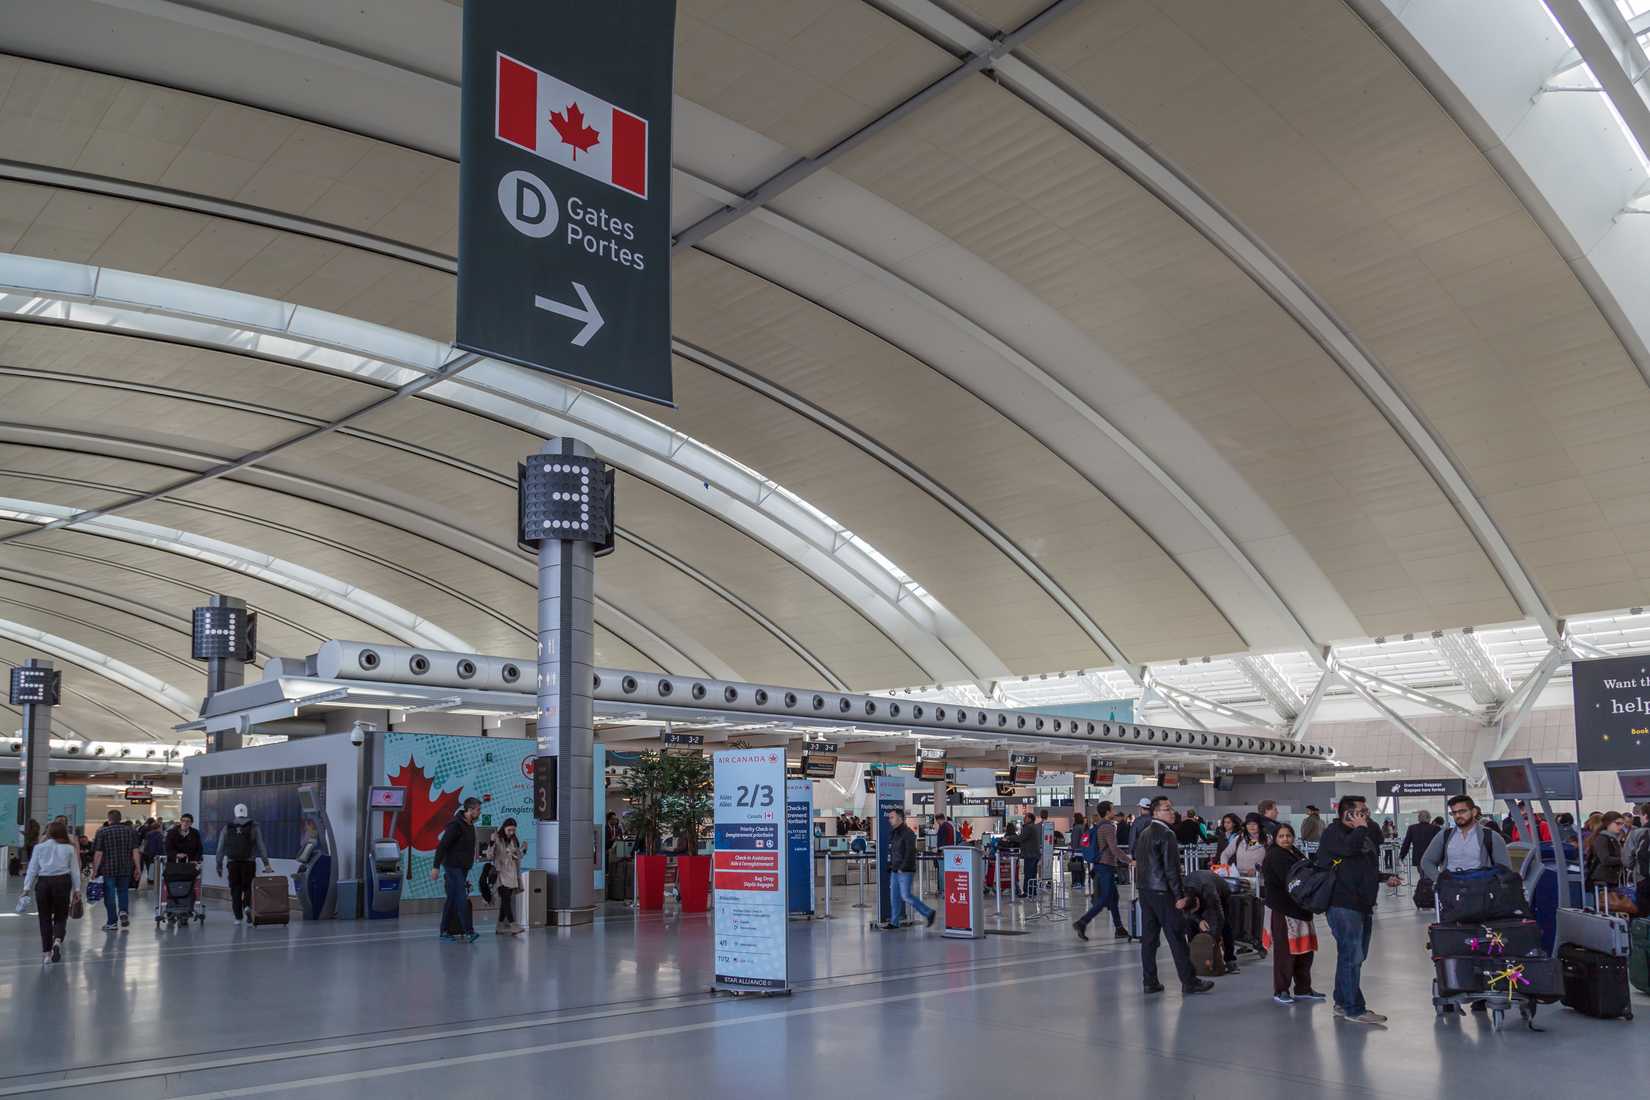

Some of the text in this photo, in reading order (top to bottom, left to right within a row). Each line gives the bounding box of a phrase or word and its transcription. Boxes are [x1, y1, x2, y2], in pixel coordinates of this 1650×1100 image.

[516, 177, 547, 225] D
[567, 196, 635, 241] Gates
[567, 224, 645, 271] Portes
[543, 463, 590, 531] 3
[204, 612, 236, 652] 4
[19, 671, 45, 700] 5
[1603, 678, 1637, 689] Want
[1610, 697, 1650, 715] help
[688, 736, 699, 744] 3-2
[719, 755, 766, 764] AIR CANADA
[538, 787, 547, 812] 3
[736, 784, 775, 808] 2/3
[501, 806, 534, 816] Enregistr
[724, 976, 767, 986] STAR ALLIANCE
